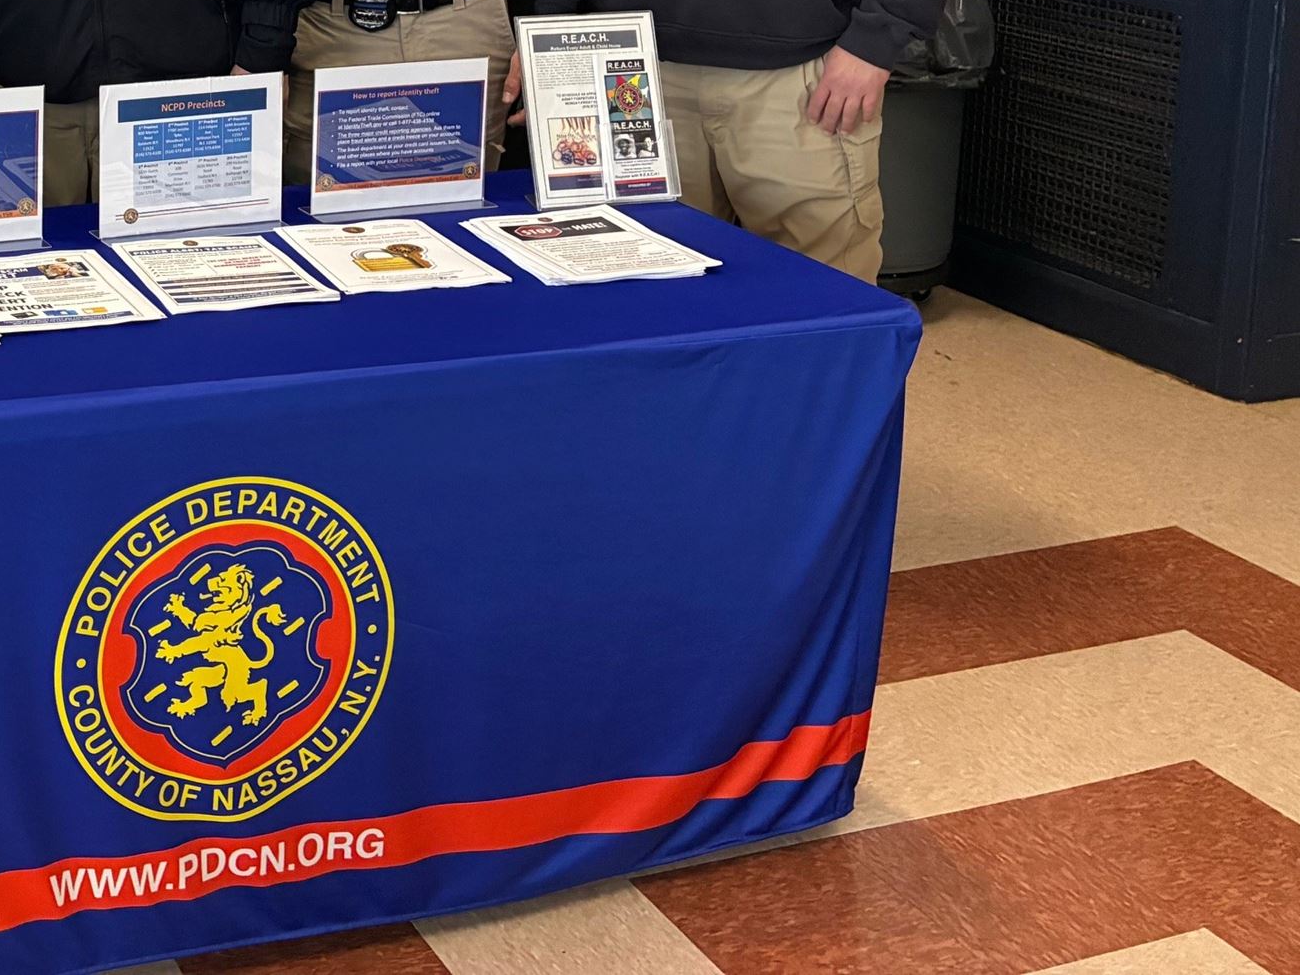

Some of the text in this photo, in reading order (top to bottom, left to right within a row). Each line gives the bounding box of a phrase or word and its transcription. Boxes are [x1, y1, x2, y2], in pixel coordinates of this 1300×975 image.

[561, 33, 610, 44] R.E.A.C.H.
[608, 61, 641, 69] R.E.A.C.H.
[161, 100, 226, 112] NCPD Precincts
[614, 121, 652, 130] R.E.A.C.H.
[522, 227, 554, 236] STOP
[571, 222, 607, 231] HATE!
[76, 489, 381, 637] POLICE DEPARTMENT
[68, 654, 382, 811] COUNTY OF NASSAU, N.Y.
[50, 827, 385, 908] WWW.PDCN.ORG
